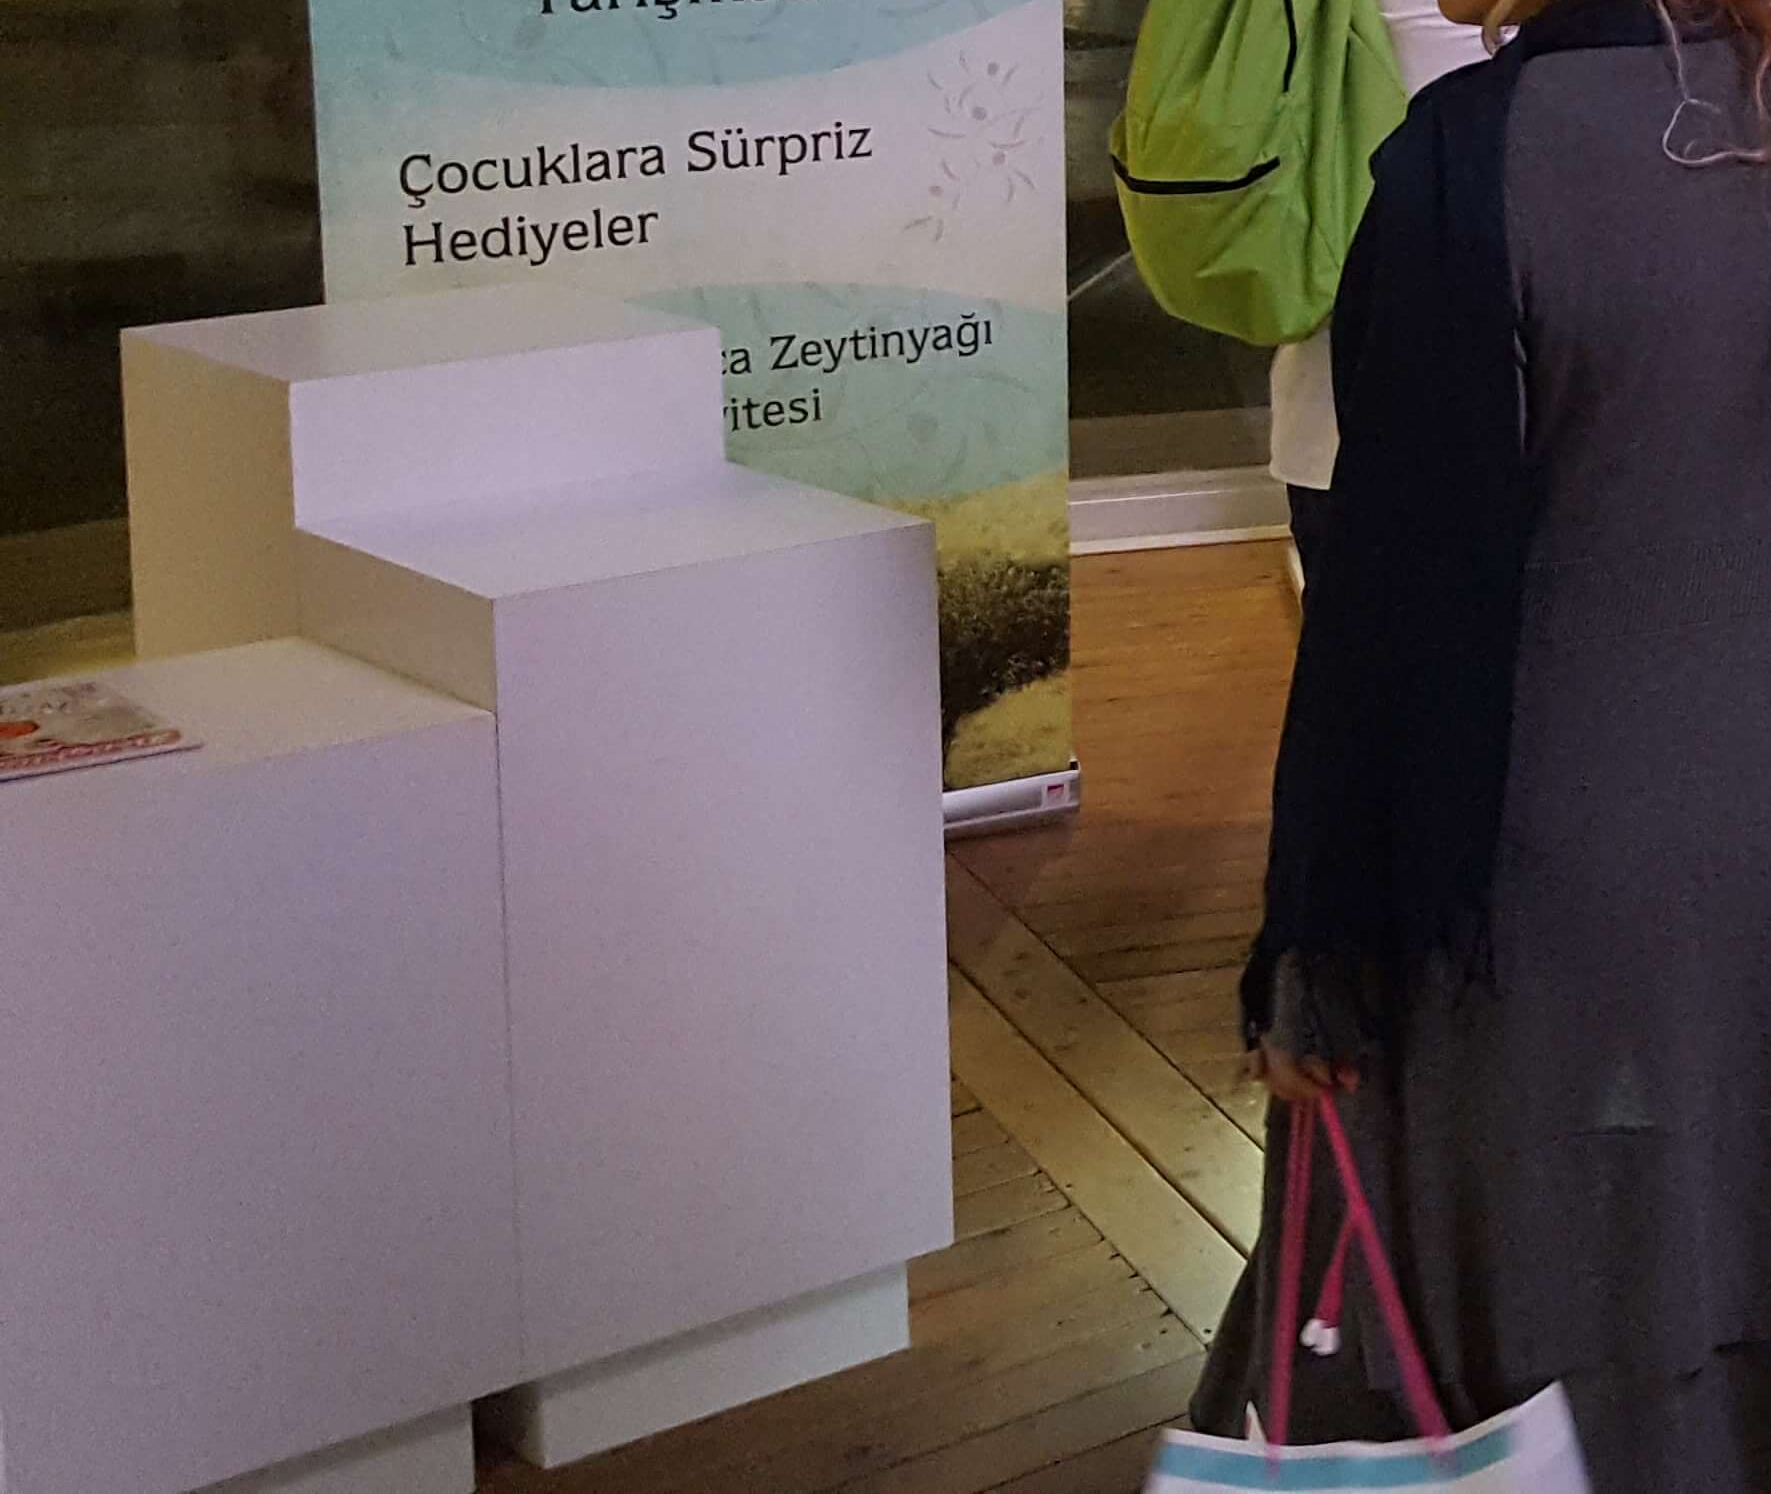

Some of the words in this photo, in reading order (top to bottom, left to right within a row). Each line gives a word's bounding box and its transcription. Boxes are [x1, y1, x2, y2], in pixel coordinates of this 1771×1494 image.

[399, 142, 667, 209] Çocuklara
[686, 121, 874, 179] Sürpriz
[403, 204, 660, 269] Hediyeler
[769, 311, 994, 374] Zeytinyağı
[722, 387, 823, 432] itesi
